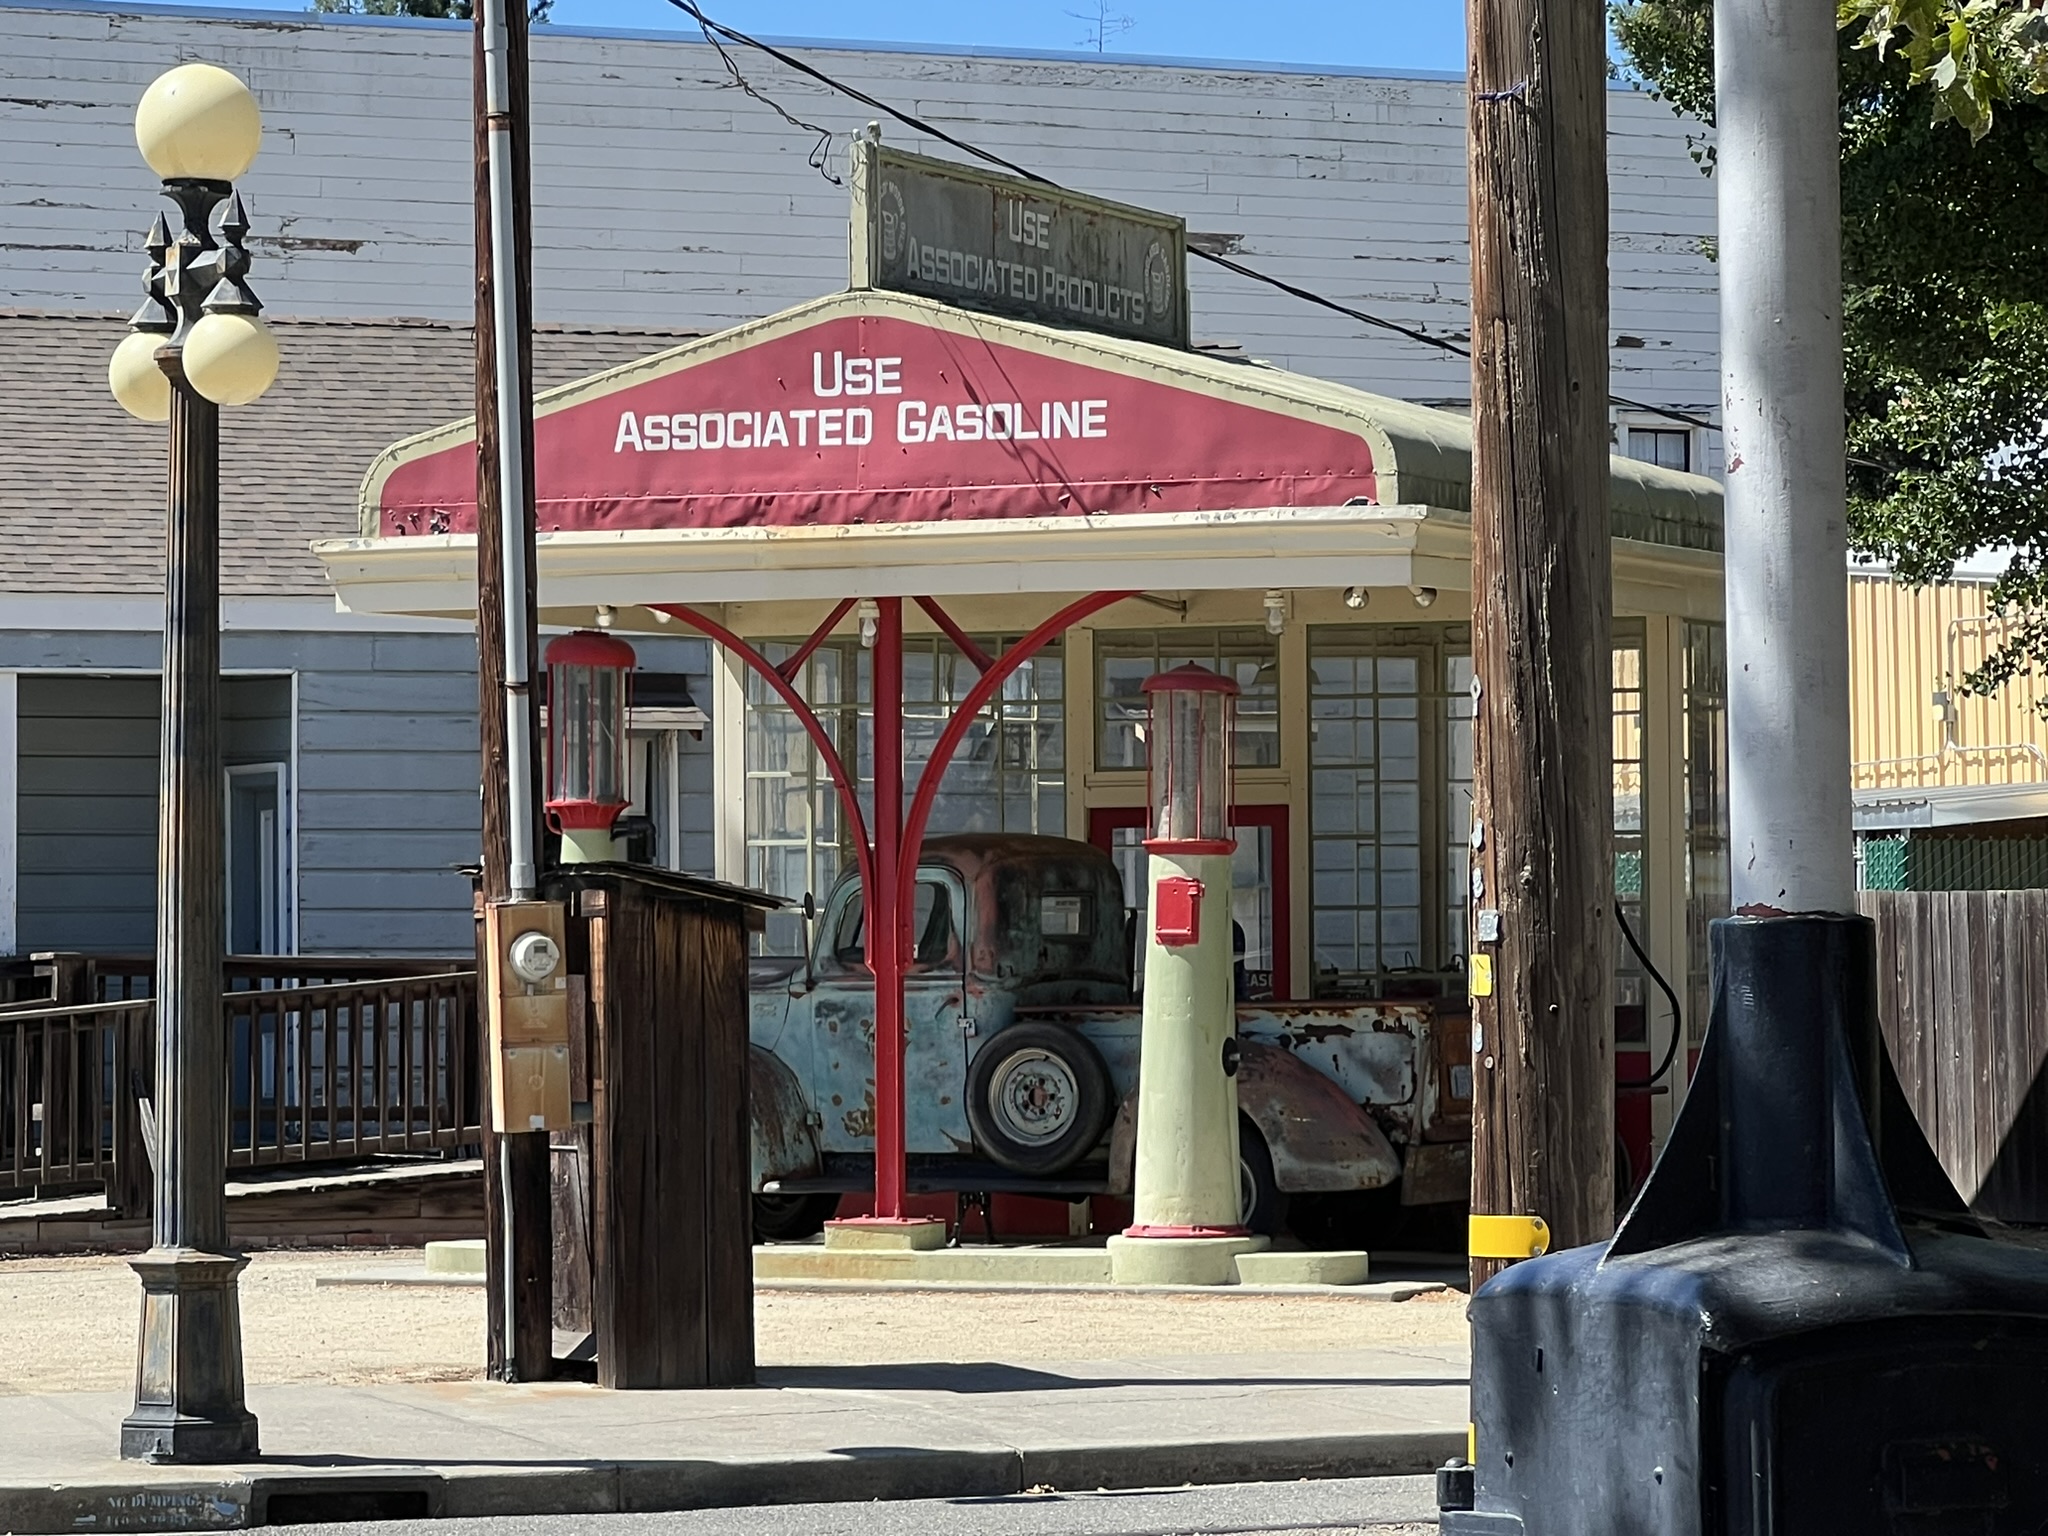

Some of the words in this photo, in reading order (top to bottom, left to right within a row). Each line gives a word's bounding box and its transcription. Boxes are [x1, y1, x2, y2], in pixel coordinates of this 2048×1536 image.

[1009, 199, 1050, 249] USE
[907, 237, 1039, 301] ASSOCIATED
[1042, 265, 1145, 325] PRODUCTS
[813, 351, 902, 397] USE
[614, 407, 873, 453] ASSOCIATED
[898, 399, 1108, 444] GASOLINE
